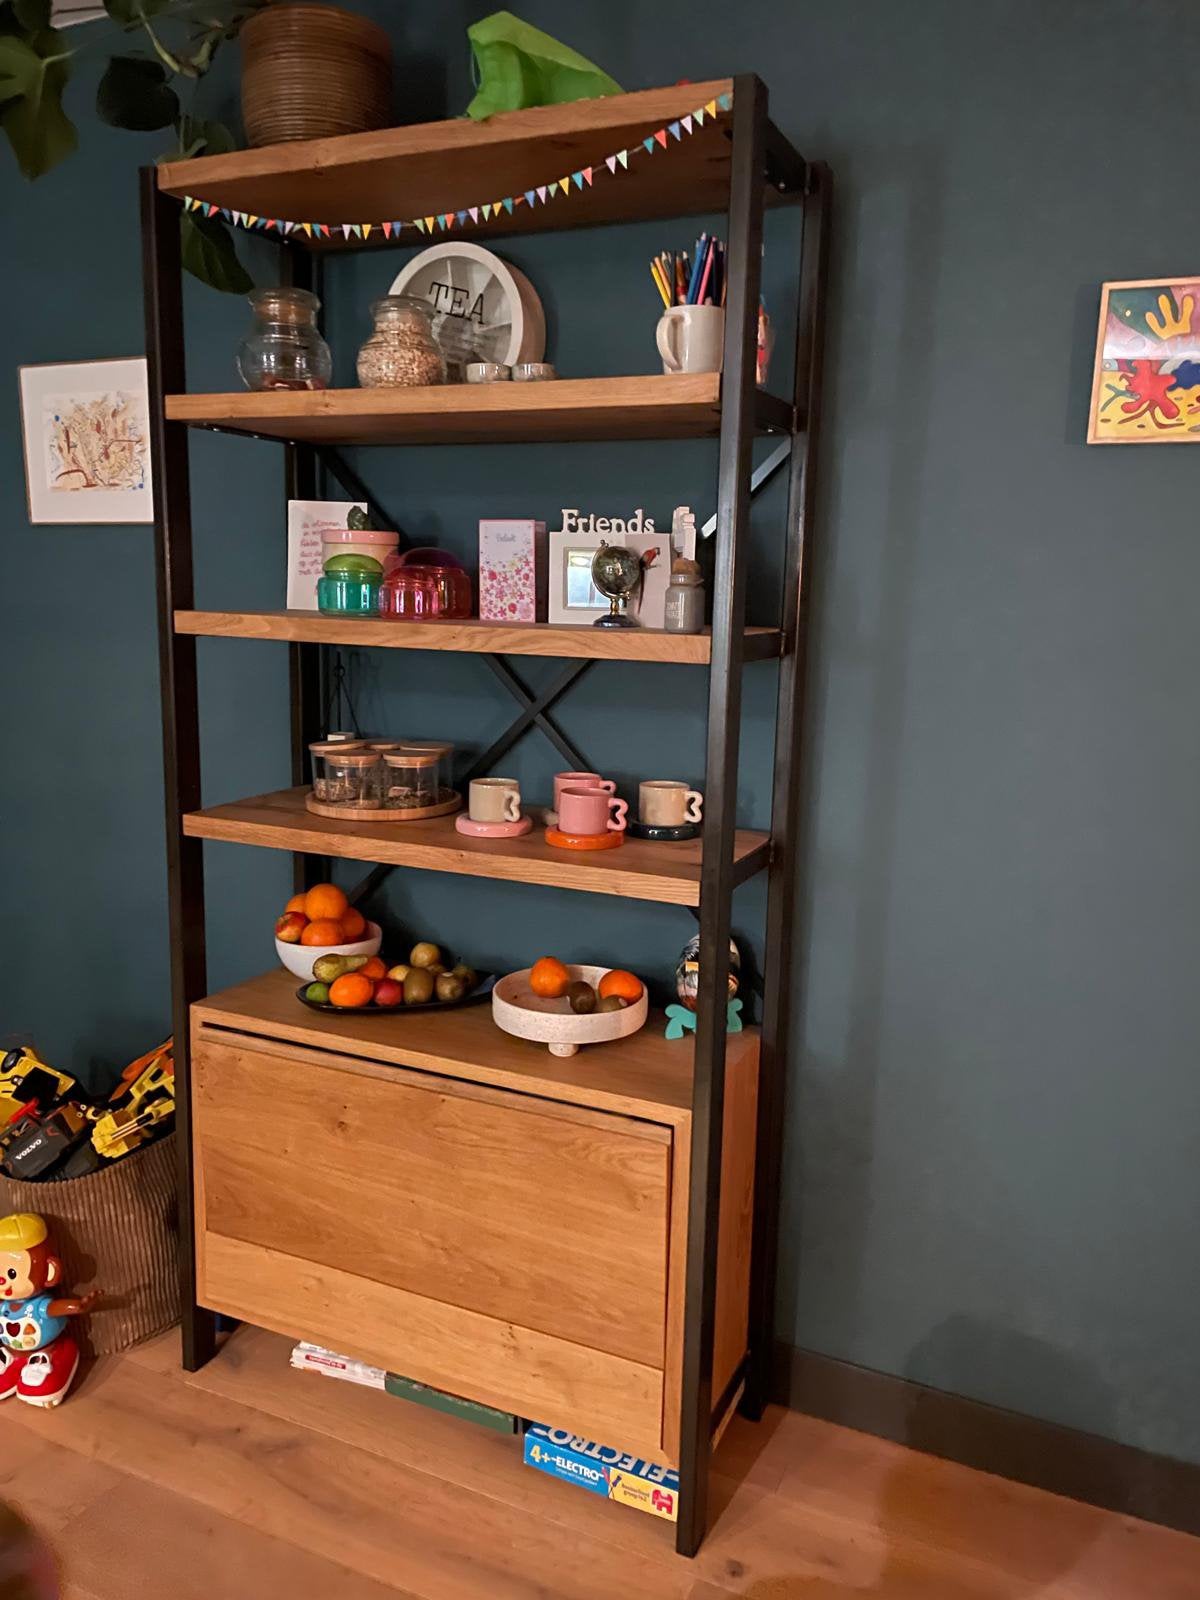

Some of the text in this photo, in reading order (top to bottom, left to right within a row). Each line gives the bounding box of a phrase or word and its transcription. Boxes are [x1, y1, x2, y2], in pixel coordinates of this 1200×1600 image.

[428, 281, 485, 325] TEA
[561, 508, 655, 534] Friends
[15, 1138, 42, 1160] VOLVO
[530, 1444, 551, 1463] 4+
